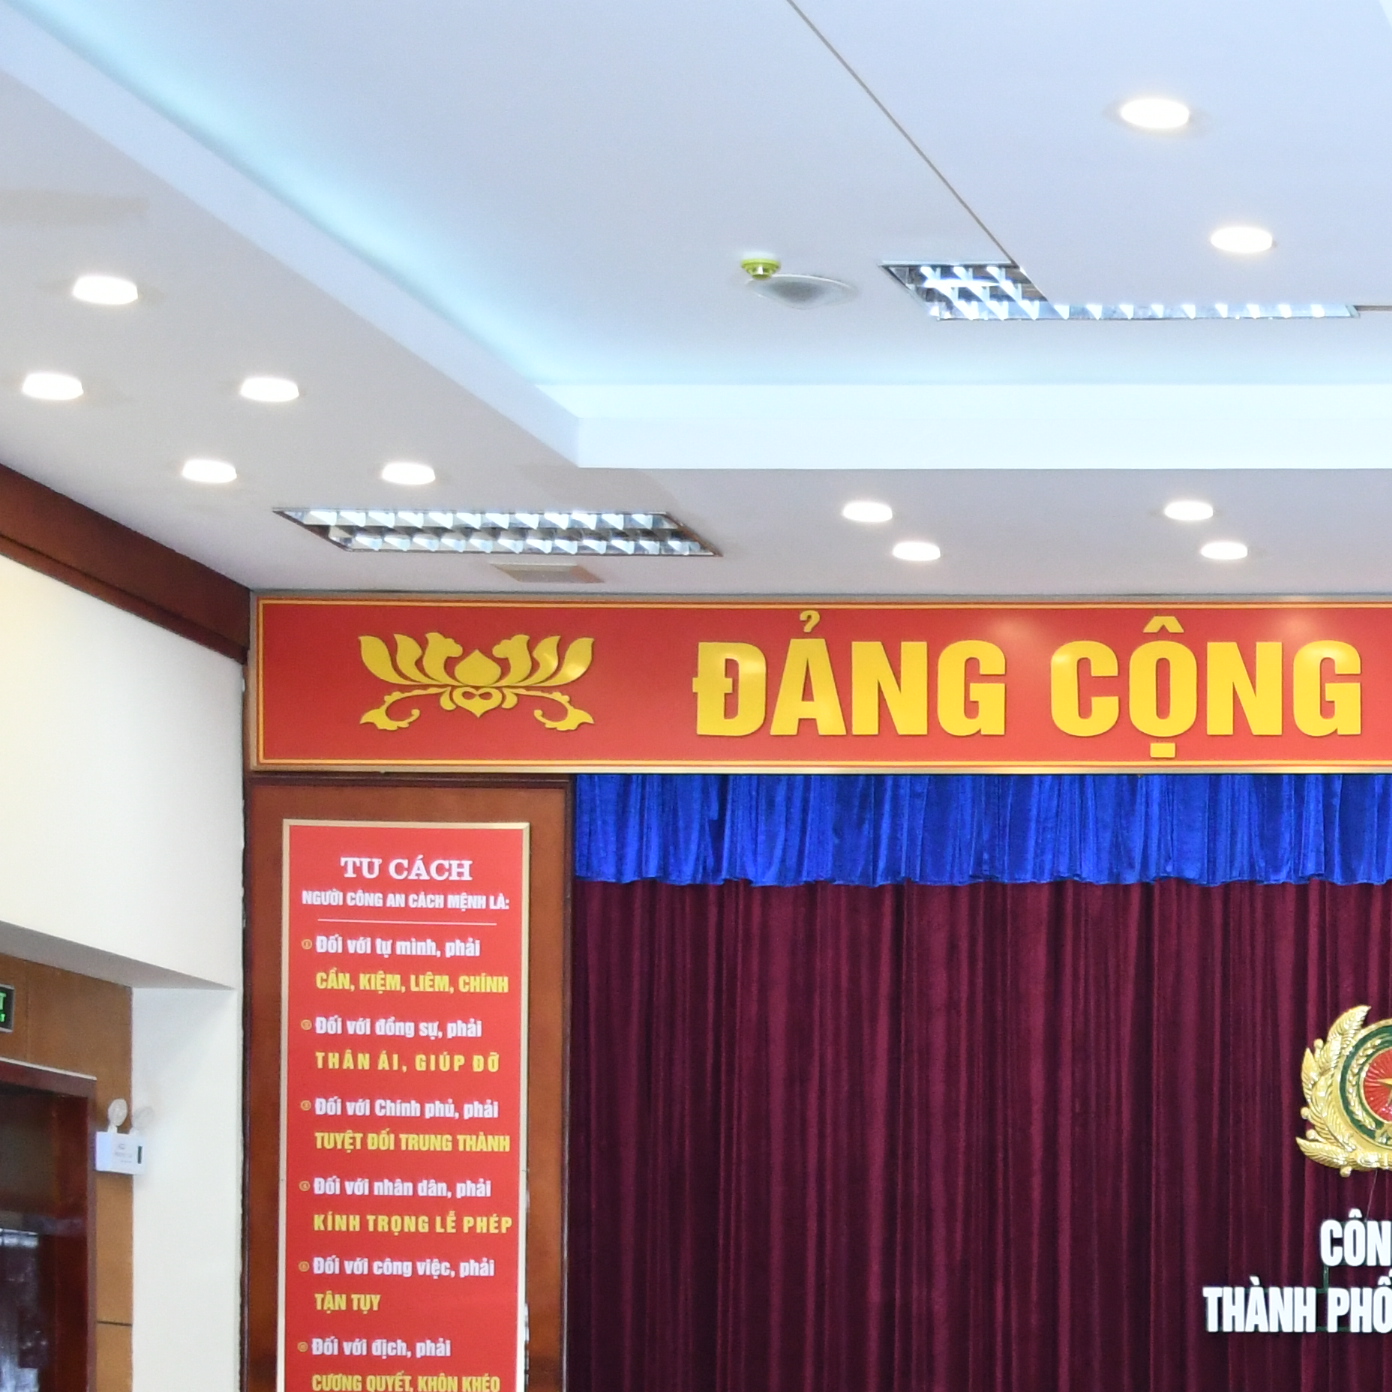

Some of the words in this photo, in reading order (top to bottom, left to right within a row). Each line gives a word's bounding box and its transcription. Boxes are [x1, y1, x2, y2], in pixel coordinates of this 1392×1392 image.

[693, 610, 1005, 736] ĐẢNG
[1051, 616, 1361, 758] CỘNG
[388, 854, 473, 881] CÁCH
[302, 888, 344, 906] NGƯỜI
[346, 889, 383, 907] CÔNG
[386, 893, 406, 908] AN
[408, 891, 445, 909] CÁCH
[447, 892, 487, 912] MỆNH
[489, 893, 510, 910] LÀ:
[315, 933, 343, 954] Đối
[346, 936, 372, 954] với
[375, 937, 393, 959] tự
[395, 937, 441, 958] mình,
[444, 937, 481, 958] phải
[316, 967, 355, 992] CẦN,
[359, 970, 406, 994] KIỆM,
[410, 971, 454, 994] LIÊM,
[458, 972, 509, 993] CHÍNH
[314, 1014, 343, 1035] Đối
[346, 1017, 371, 1035] với
[374, 1016, 415, 1038] đồng
[418, 1021, 443, 1040] sự,
[446, 1017, 482, 1039] phải
[315, 1049, 370, 1070] THÂN
[377, 1050, 407, 1073] ÁI,
[415, 1051, 465, 1072] GIÚP
[472, 1051, 500, 1073] ĐỠ
[314, 1096, 342, 1115] Đối
[346, 1098, 371, 1116] với
[374, 1099, 421, 1117] Chính
[424, 1098, 460, 1119] phủ,
[463, 1099, 499, 1120] phải
[315, 1129, 363, 1153] TUYỆT
[367, 1130, 395, 1151] ĐỐI
[399, 1133, 453, 1152] TRUNG
[456, 1131, 511, 1152] THÀNH
[313, 1175, 341, 1195] Đối
[344, 1178, 370, 1196] với
[373, 1178, 414, 1196] nhân
[455, 1178, 492, 1199] phải
[313, 1211, 360, 1232] KÍNH
[366, 1214, 429, 1236] TRỌNG
[435, 1210, 457, 1233] LỄ
[462, 1213, 513, 1234] PHÉP
[312, 1255, 340, 1275] Đối
[343, 1257, 369, 1275] với
[372, 1257, 413, 1278] công
[416, 1258, 456, 1280] việc,
[459, 1257, 495, 1278] phải
[314, 1290, 347, 1314] TẬN
[350, 1293, 381, 1315] TỤY
[1203, 1277, 1316, 1332] THÀNH
[311, 1335, 339, 1356] Đối
[342, 1338, 368, 1356] với
[371, 1338, 412, 1360] địch,
[415, 1337, 451, 1359] phải
[312, 1373, 362, 1392] CƯƠNG
[417, 1372, 458, 1392] KHÔN
[461, 1373, 501, 1392] KHÉO
